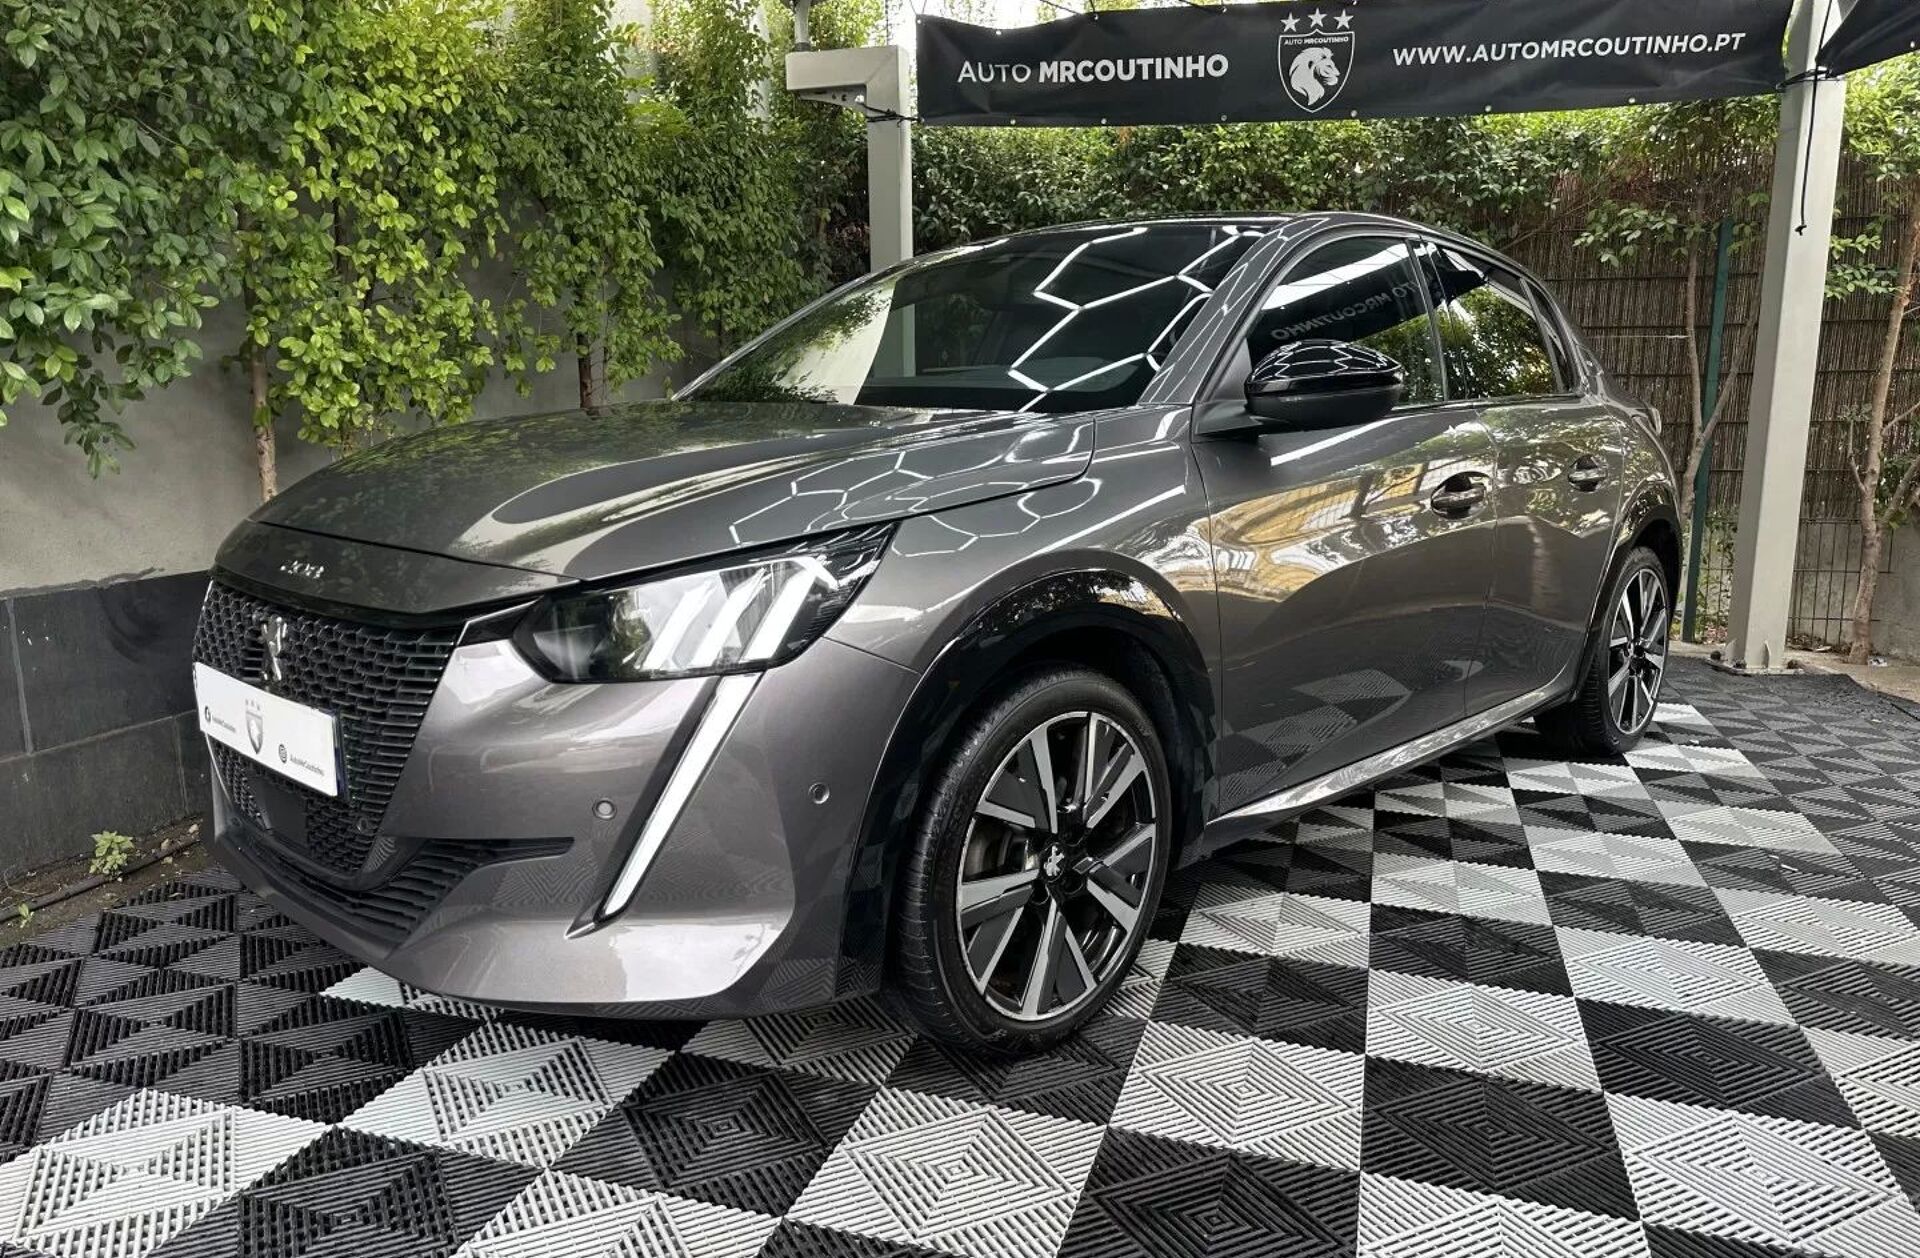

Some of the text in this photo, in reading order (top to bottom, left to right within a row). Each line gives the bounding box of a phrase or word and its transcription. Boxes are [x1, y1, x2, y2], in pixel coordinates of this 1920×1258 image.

[1392, 32, 1746, 66] WWW.AUTOMRCOUTINHO.PT
[957, 53, 1229, 84] AUTO MRCOUTINHO
